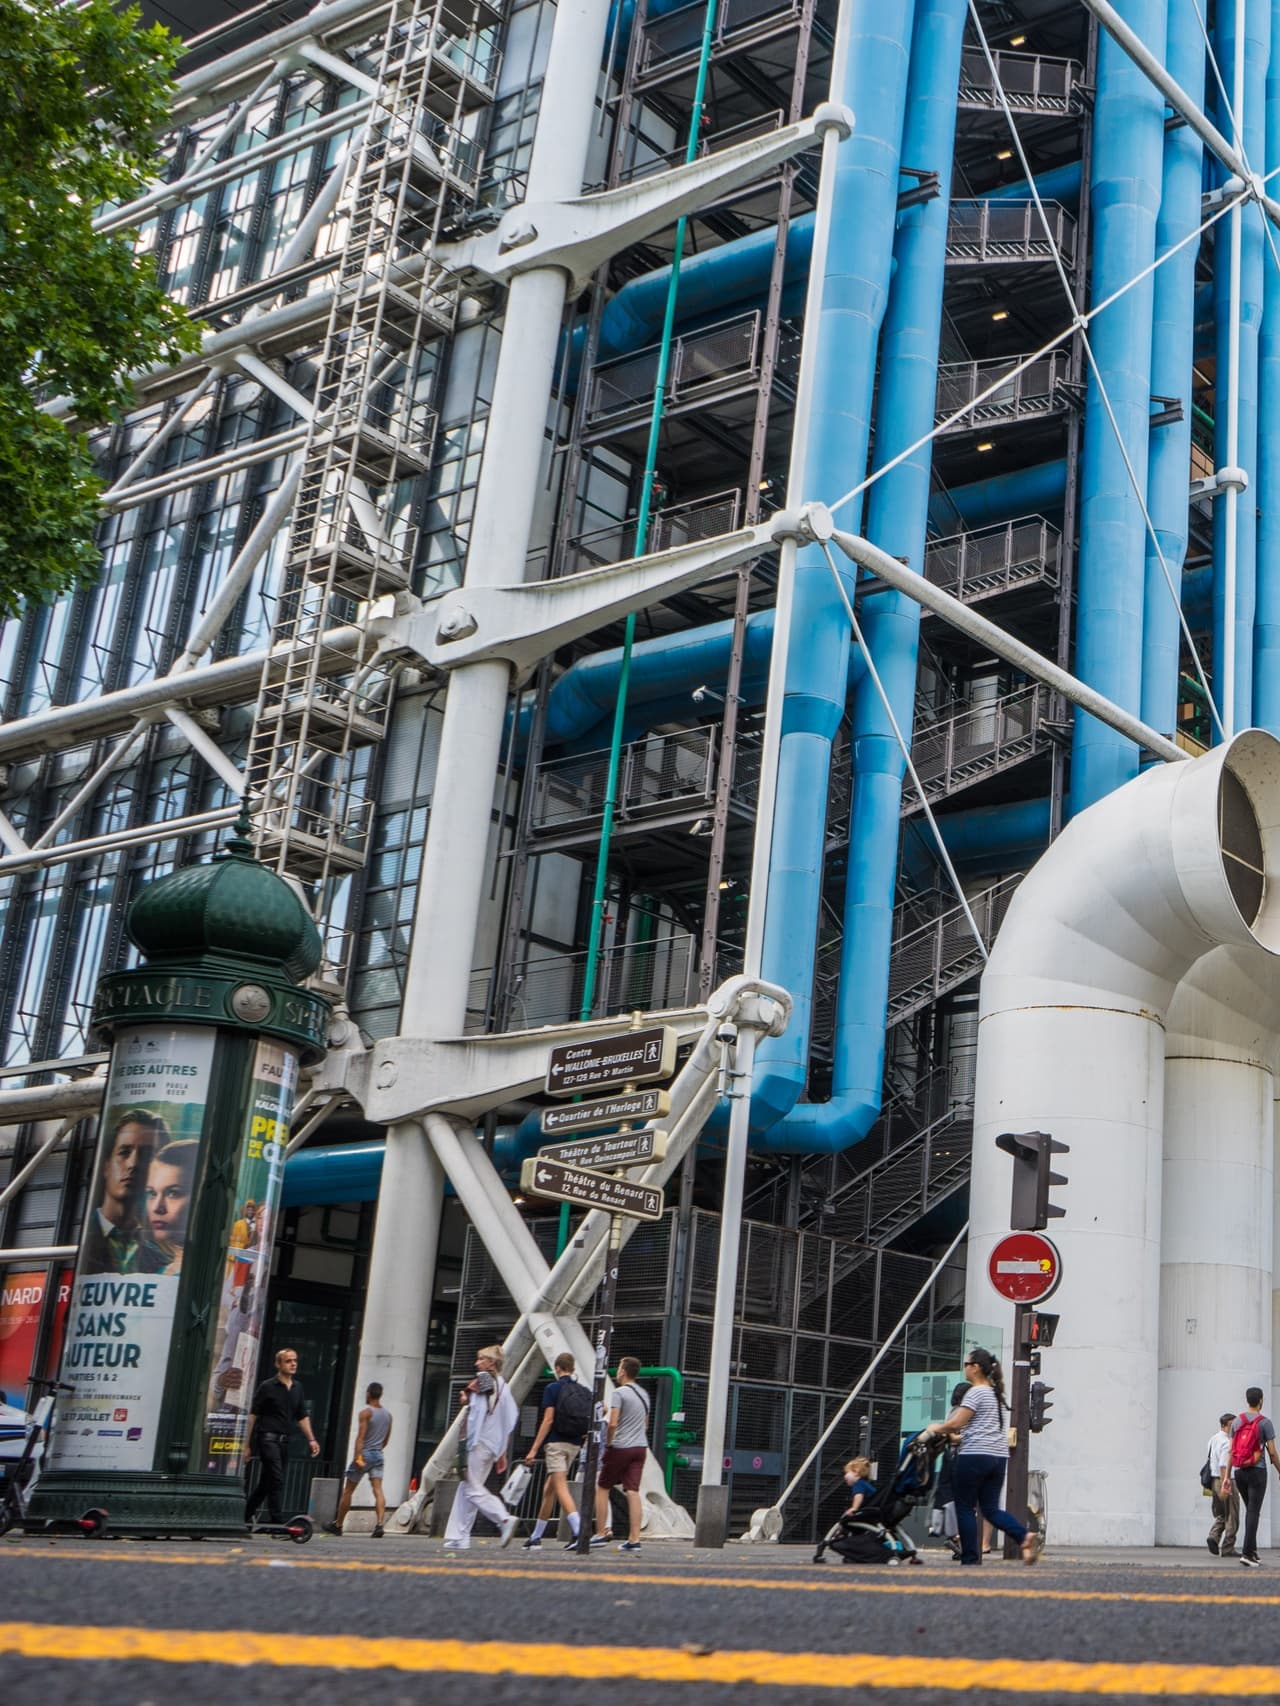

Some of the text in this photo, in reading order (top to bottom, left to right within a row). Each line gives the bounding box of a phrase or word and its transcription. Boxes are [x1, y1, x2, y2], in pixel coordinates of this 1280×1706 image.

[564, 1049, 644, 1073] WALLONIE-BRUXELLES
[566, 1048, 593, 1060] Centre
[126, 1065, 145, 1075] DES
[147, 1064, 198, 1077] AUTRES
[611, 1065, 635, 1077] Martin
[558, 1101, 642, 1123] Quartier de l'Horloge
[559, 1139, 638, 1159] Théâtre du Tourtour
[563, 1171, 645, 1200] Théâtre du Renard
[572, 1186, 588, 1198] Rue
[601, 1192, 627, 1206] Renard
[2, 1286, 42, 1305] NARD
[75, 1312, 127, 1337] SANS
[103, 1373, 109, 1381] &
[111, 1373, 118, 1382] 2
[76, 1412, 111, 1422] JUILLET
